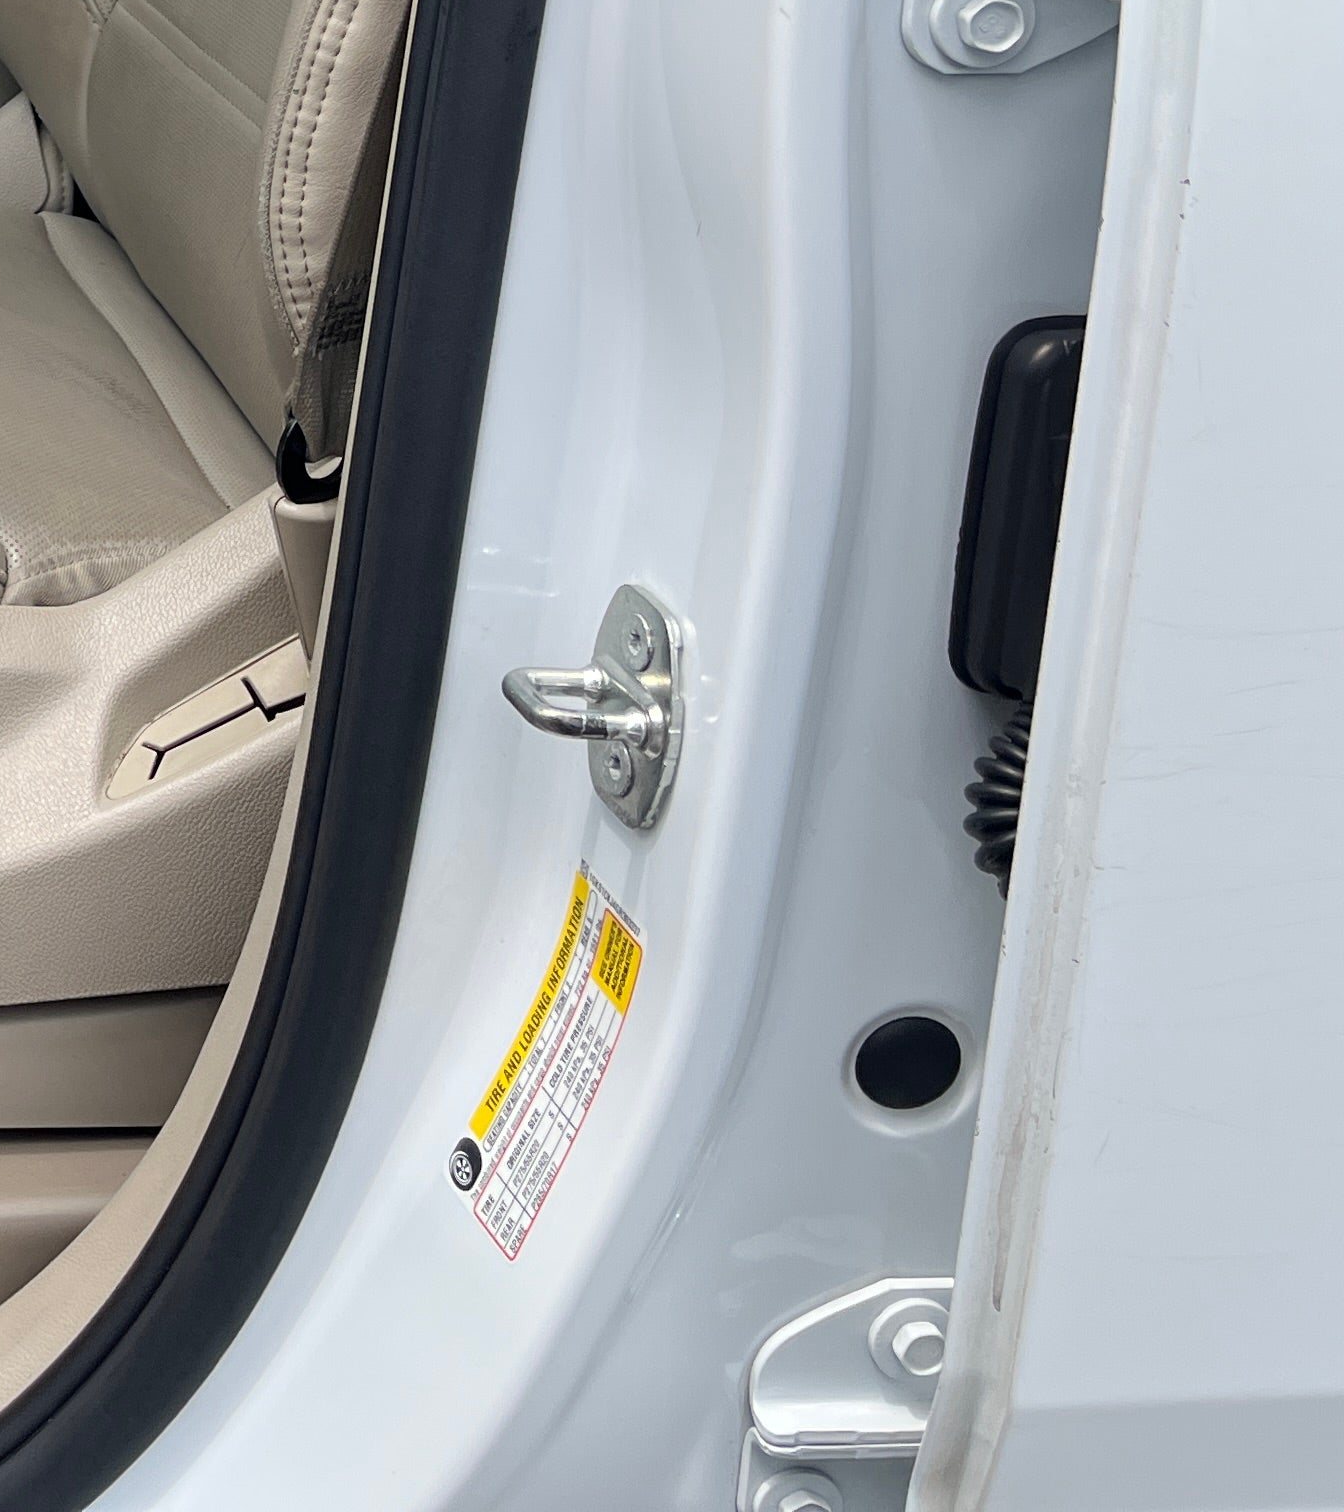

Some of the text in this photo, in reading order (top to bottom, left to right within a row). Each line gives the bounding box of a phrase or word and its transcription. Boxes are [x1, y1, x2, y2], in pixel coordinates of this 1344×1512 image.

[481, 1193, 495, 1217] TIRE
[548, 1065, 564, 1088] COLD
[560, 1044, 572, 1064] TIRE
[570, 996, 592, 1044] PRESSURE
[485, 896, 584, 1112] TIRE AND LOADING INFORMATION
